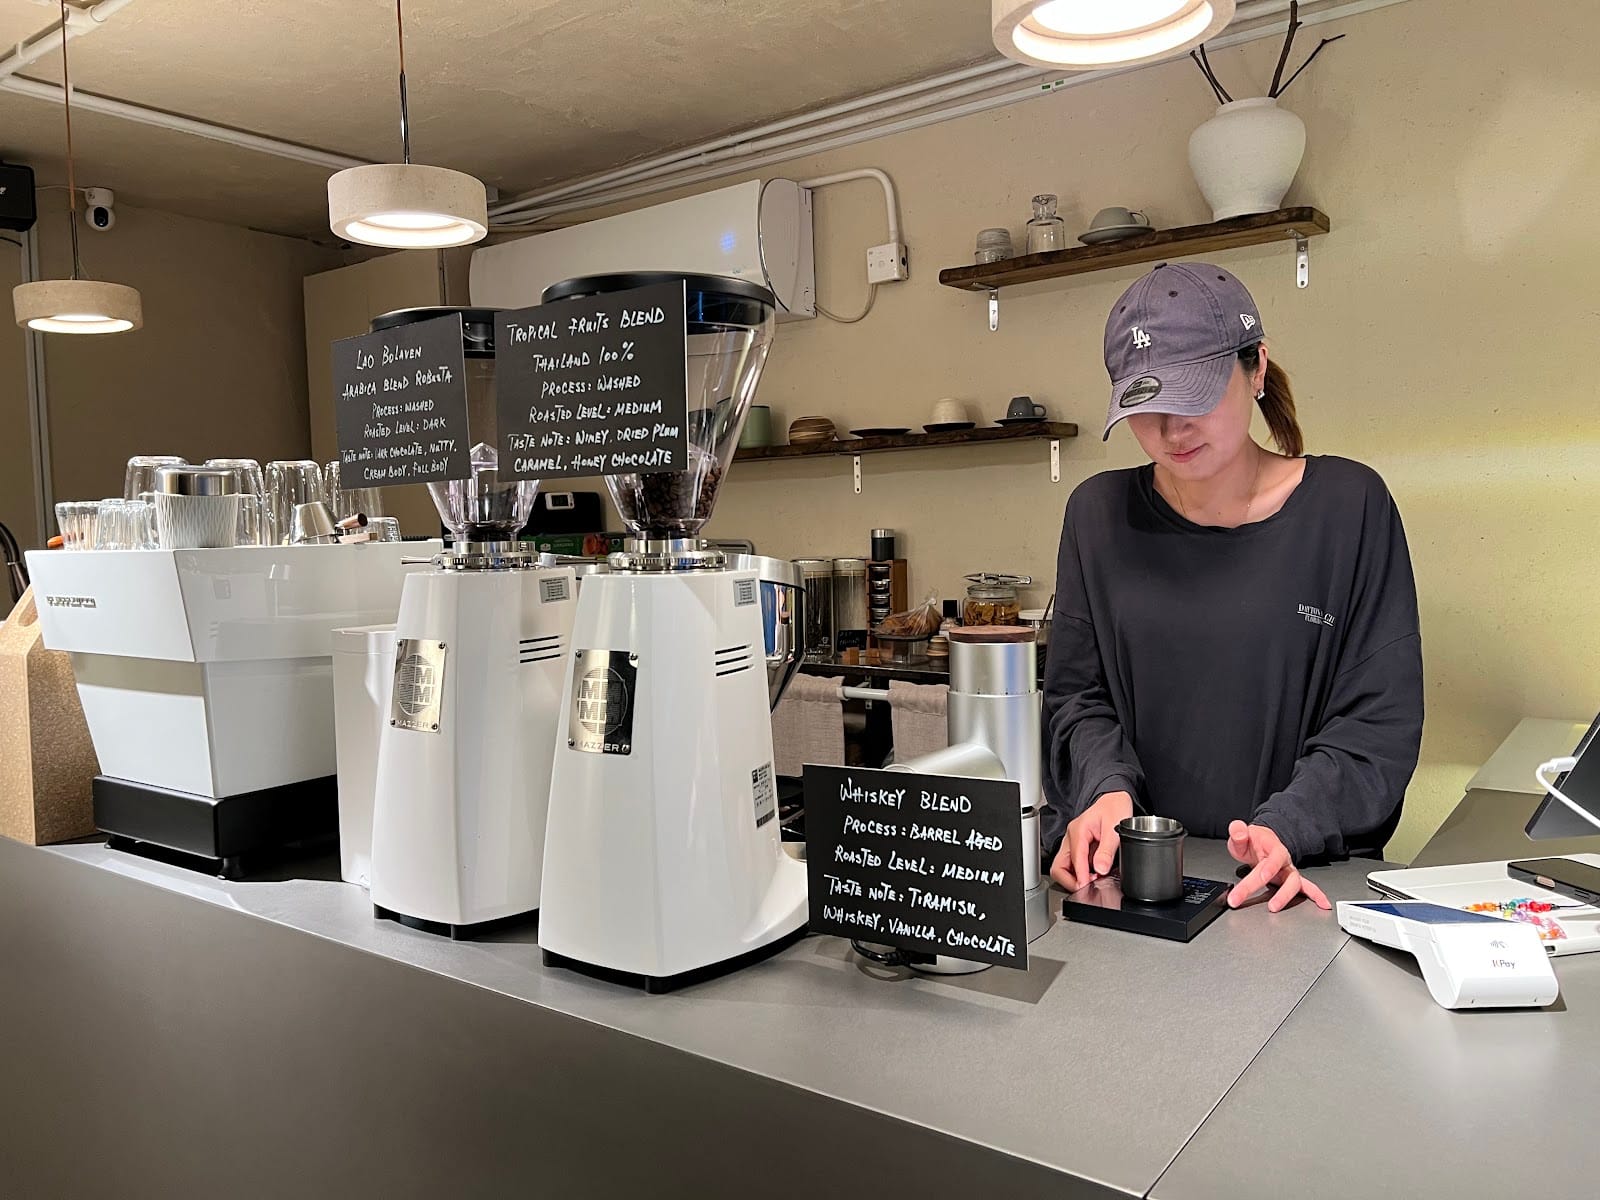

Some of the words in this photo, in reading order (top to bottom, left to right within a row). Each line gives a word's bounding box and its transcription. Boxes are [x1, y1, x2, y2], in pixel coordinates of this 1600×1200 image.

[507, 321, 558, 346] TROPICAL
[568, 313, 609, 336] FRUITS
[620, 307, 665, 329] BLEND
[1131, 326, 1151, 349] LA
[356, 349, 375, 370] LAO
[382, 344, 422, 366] BOLAVEN
[533, 352, 590, 373] THAILAND
[599, 341, 635, 365] 100%
[342, 381, 377, 401] ARABICA
[383, 376, 409, 392] BLEND
[415, 366, 453, 386] ROBUSTA
[541, 381, 592, 399] PROCESS:
[597, 375, 641, 392] WASHED
[371, 402, 403, 419] PROCESS:
[529, 404, 573, 423] ROASTED
[576, 403, 611, 420] LEVEL:
[614, 400, 662, 417] MEDIUM
[364, 422, 391, 438] ROASTED
[395, 421, 420, 434] LEVEL:
[423, 417, 447, 431] DARK
[507, 433, 536, 451] TASTE
[540, 431, 571, 448] NOTE:
[617, 427, 649, 442] DRIED
[652, 423, 679, 442] PLUM
[341, 449, 357, 464] TASTE
[363, 467, 386, 480] CREAM
[412, 461, 430, 477] FULL
[431, 457, 449, 475] BODY
[514, 455, 568, 473] CARAMEL,
[571, 453, 607, 473] HONEY
[611, 448, 672, 467] CHOCOLATE
[840, 777, 906, 810] WHISKEY
[920, 790, 972, 813] BLEND
[909, 823, 961, 845] BARREL
[965, 829, 1003, 851] AGED
[834, 844, 882, 868] ROASTED
[887, 850, 936, 875] LEVEL:
[941, 863, 1005, 887] MEDIUM
[823, 874, 862, 897] TASTE
[868, 882, 905, 903] NOTE:
[908, 887, 987, 921] TIRAMISU,
[823, 904, 885, 933] WHISKEY,
[945, 928, 1016, 957] CHOCOLATE
